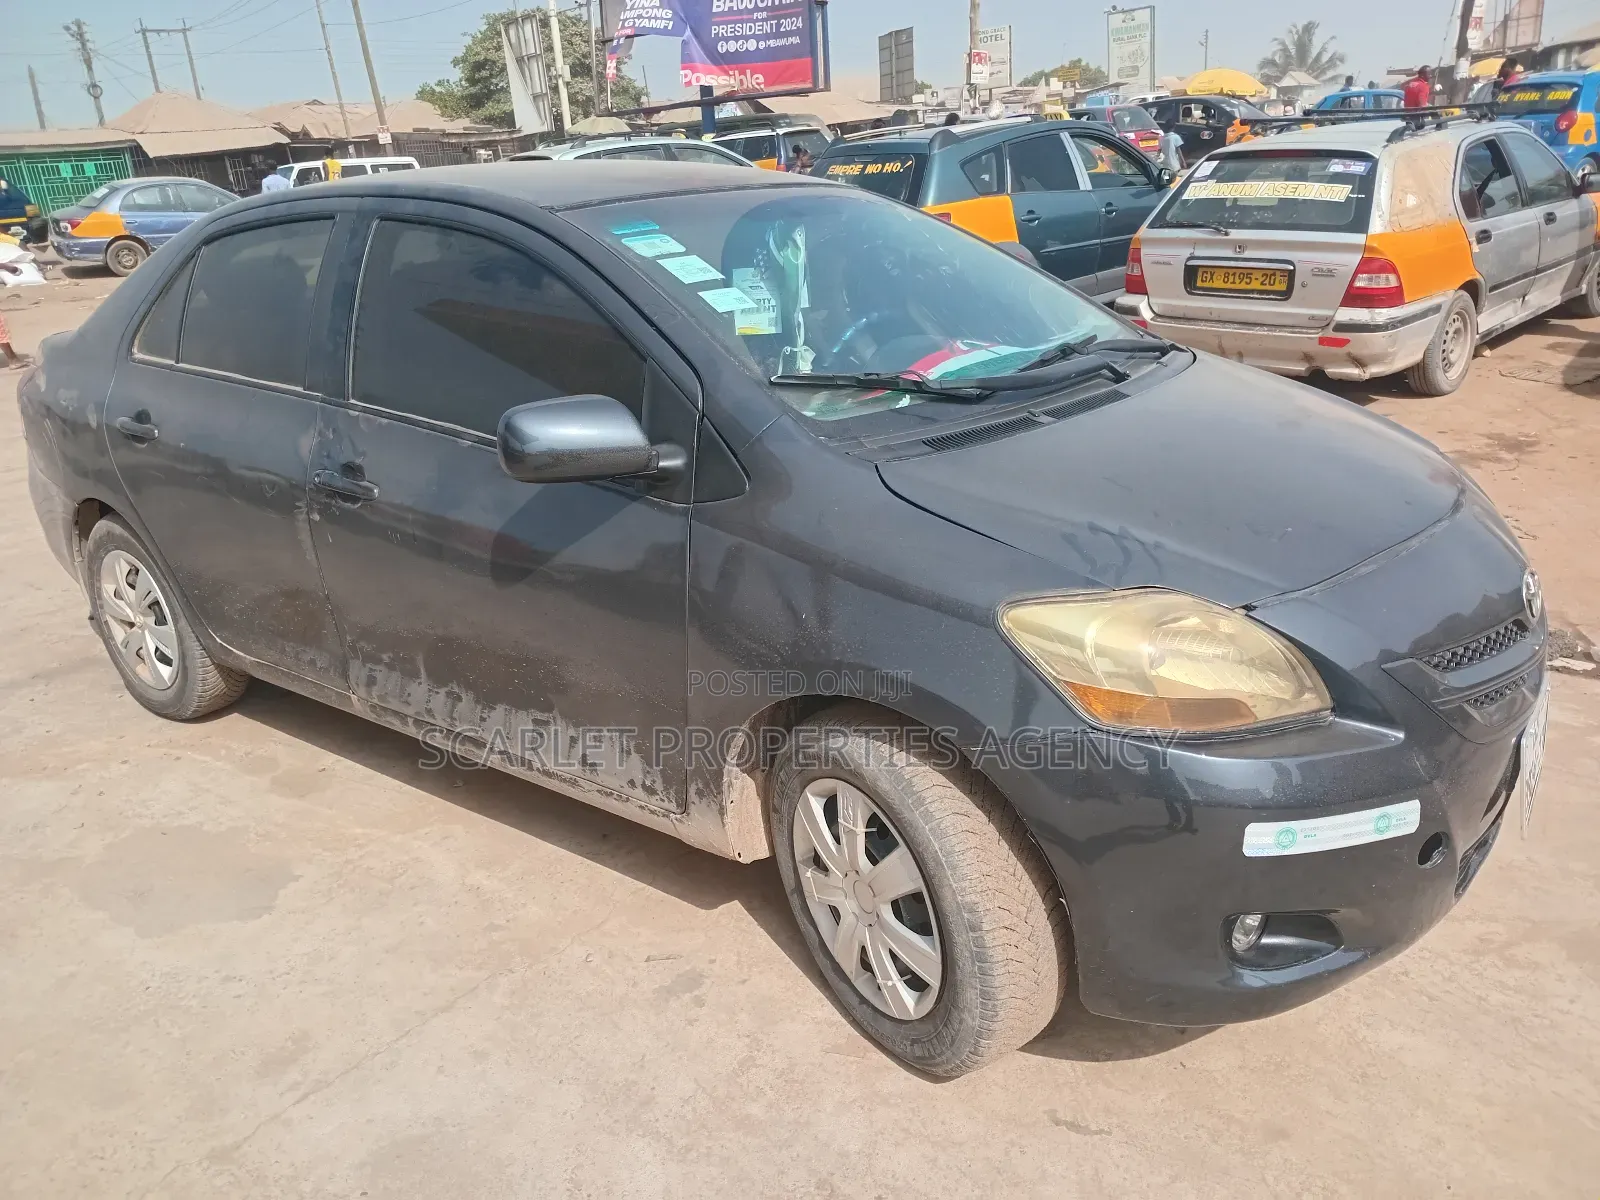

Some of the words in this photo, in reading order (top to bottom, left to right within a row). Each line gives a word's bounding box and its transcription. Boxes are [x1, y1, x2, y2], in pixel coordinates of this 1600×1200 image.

[753, 11, 768, 20] FOR
[624, 18, 674, 30] GYAMFI
[711, 20, 778, 38] PRESIDENT
[779, 16, 803, 32] 2024
[1260, 184, 1312, 198] ASEM
[1314, 185, 1351, 200] NTI
[1200, 270, 1216, 284] GX
[1222, 272, 1277, 287] 8195-20
